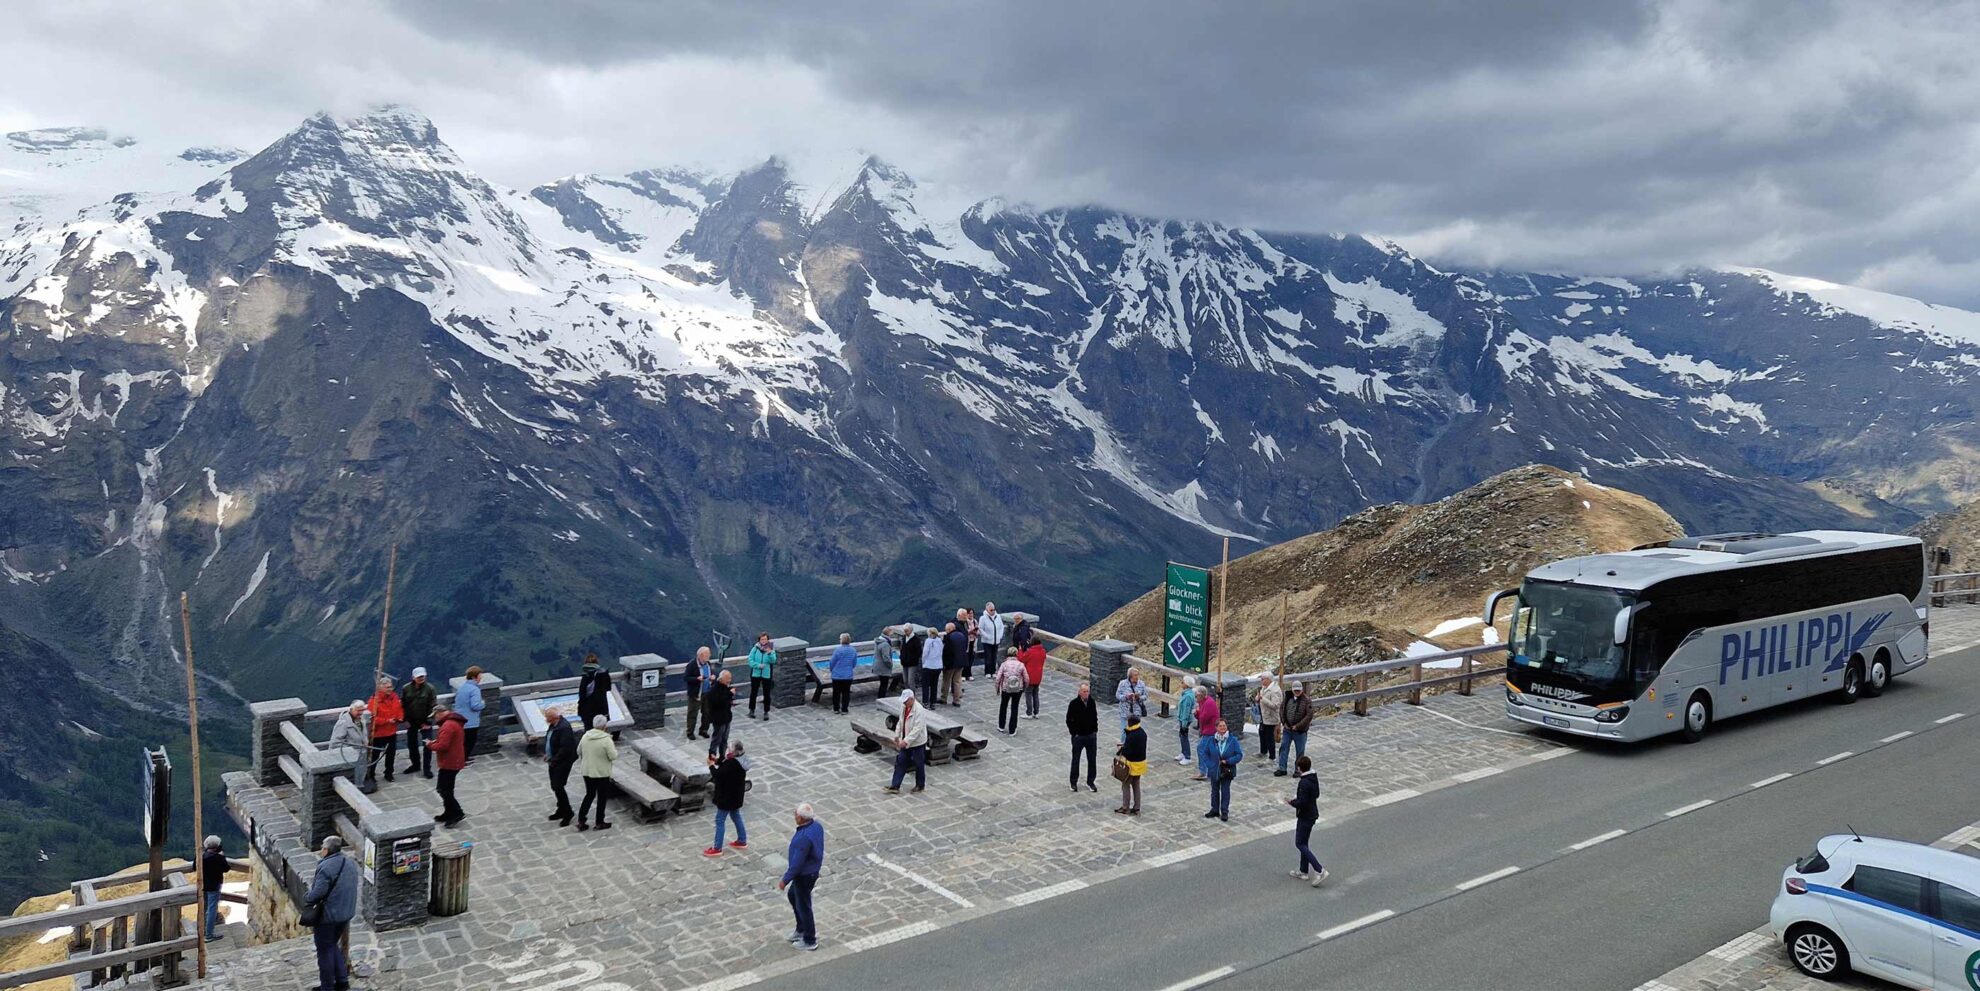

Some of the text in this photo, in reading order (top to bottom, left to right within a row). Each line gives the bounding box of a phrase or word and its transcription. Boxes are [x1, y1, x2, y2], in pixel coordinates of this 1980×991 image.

[1169, 585, 1203, 600] Glockner-
[1185, 604, 1203, 617] blick
[1177, 642, 1183, 653] 5
[1720, 611, 1852, 686] PHILIPPI
[1530, 682, 1577, 700] PHILIPPI
